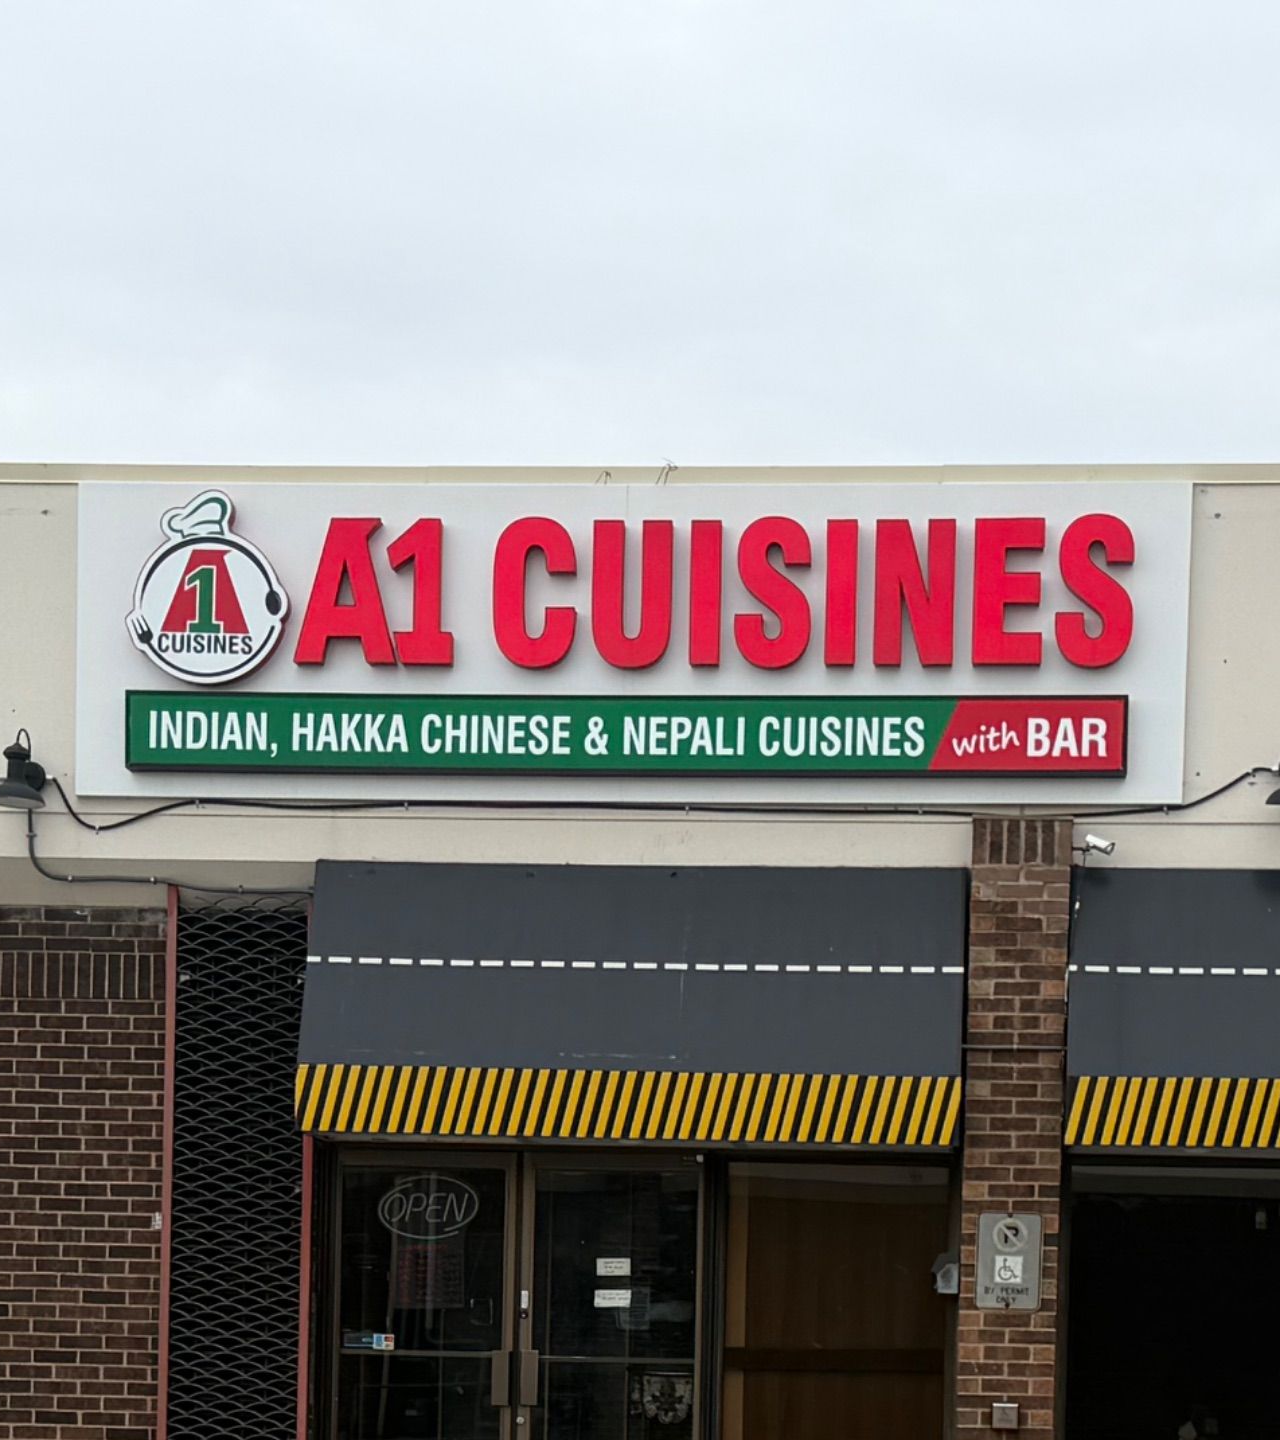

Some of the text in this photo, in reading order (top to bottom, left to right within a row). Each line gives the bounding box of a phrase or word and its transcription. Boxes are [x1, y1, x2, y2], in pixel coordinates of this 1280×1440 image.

[294, 513, 1136, 669] A1 CUISINES
[157, 633, 253, 655] CUISINES
[149, 710, 1108, 758] INDIAN, HAKKA CHINESE & NEPALI CUISINES with BAR
[384, 1193, 469, 1222] OPEN
[1001, 1286, 1029, 1296] PERMIT
